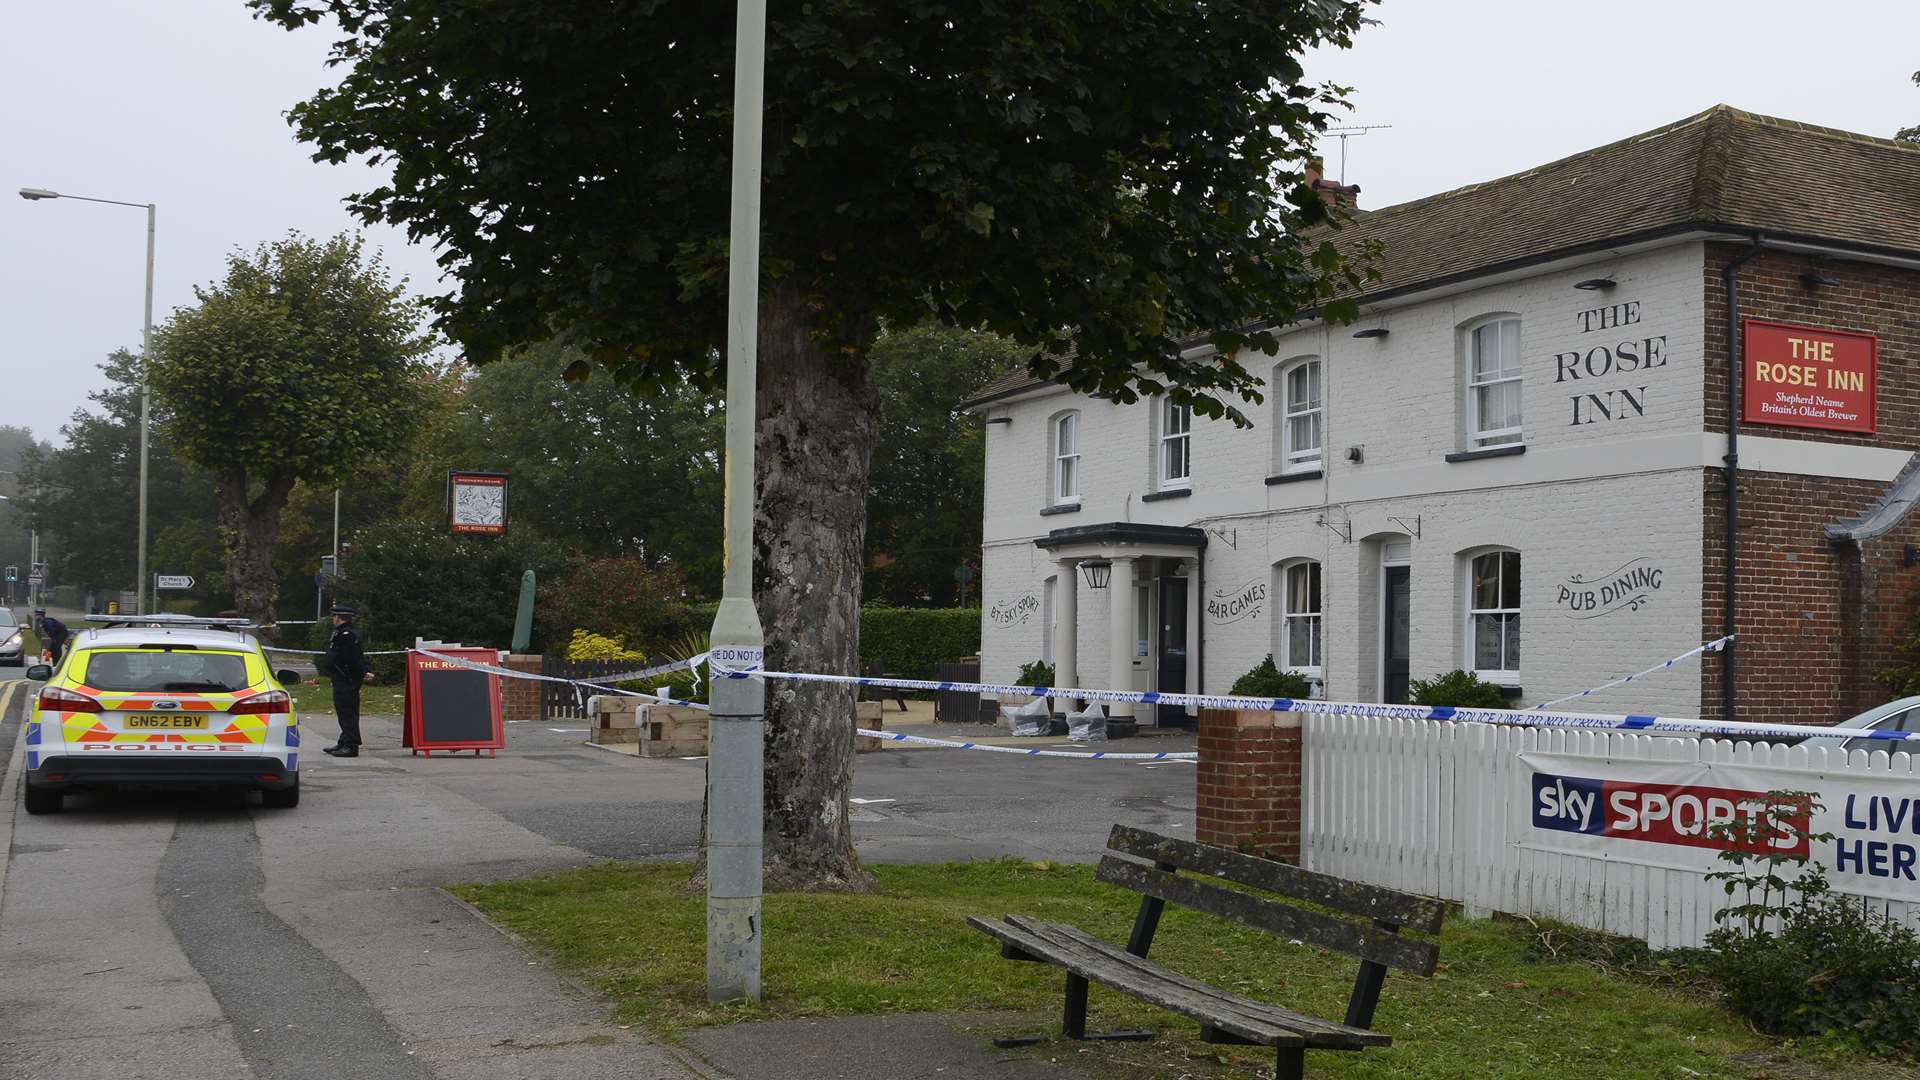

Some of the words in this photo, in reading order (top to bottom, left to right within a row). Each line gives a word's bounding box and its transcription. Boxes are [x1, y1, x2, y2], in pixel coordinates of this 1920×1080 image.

[1577, 301, 1640, 333] THE
[1788, 338, 1834, 363] THE
[1553, 336, 1666, 383] ROSE
[1756, 361, 1816, 388] ROSE
[1827, 369, 1864, 392] INN
[1568, 386, 1648, 425] INN
[1776, 392, 1813, 405] Shepherd
[1816, 396, 1844, 408] Neame
[1762, 403, 1797, 415] Britain's
[1799, 406, 1825, 418] Oldest
[1828, 410, 1858, 421] Brewer
[1557, 584, 1596, 610] PUB
[1600, 567, 1662, 605] DINING
[1208, 600, 1228, 618] BAR
[1230, 584, 1265, 615] GAMES
[1004, 606, 1017, 623] SKY
[723, 650, 735, 660] DO
[737, 650, 754, 661] NOT
[418, 661, 438, 669] THE
[1161, 696, 1186, 705] POLICE
[1188, 697, 1205, 706] LINE
[1207, 698, 1219, 708] DO
[1220, 699, 1236, 709] NOT
[1238, 700, 1267, 711] CROSS
[1294, 702, 1326, 713] POLICE
[1327, 704, 1348, 714] LINE
[1351, 705, 1364, 716] DO
[1366, 707, 1387, 717] NOT
[1388, 707, 1424, 719] CROSS
[129, 716, 168, 727] GN62
[174, 716, 202, 727] EBV
[1457, 711, 1496, 722] POLICE
[1498, 713, 1524, 724] LINE
[83, 744, 244, 752] POLICE
[1539, 779, 1595, 832] sky
[1610, 791, 1799, 849] SPORTS
